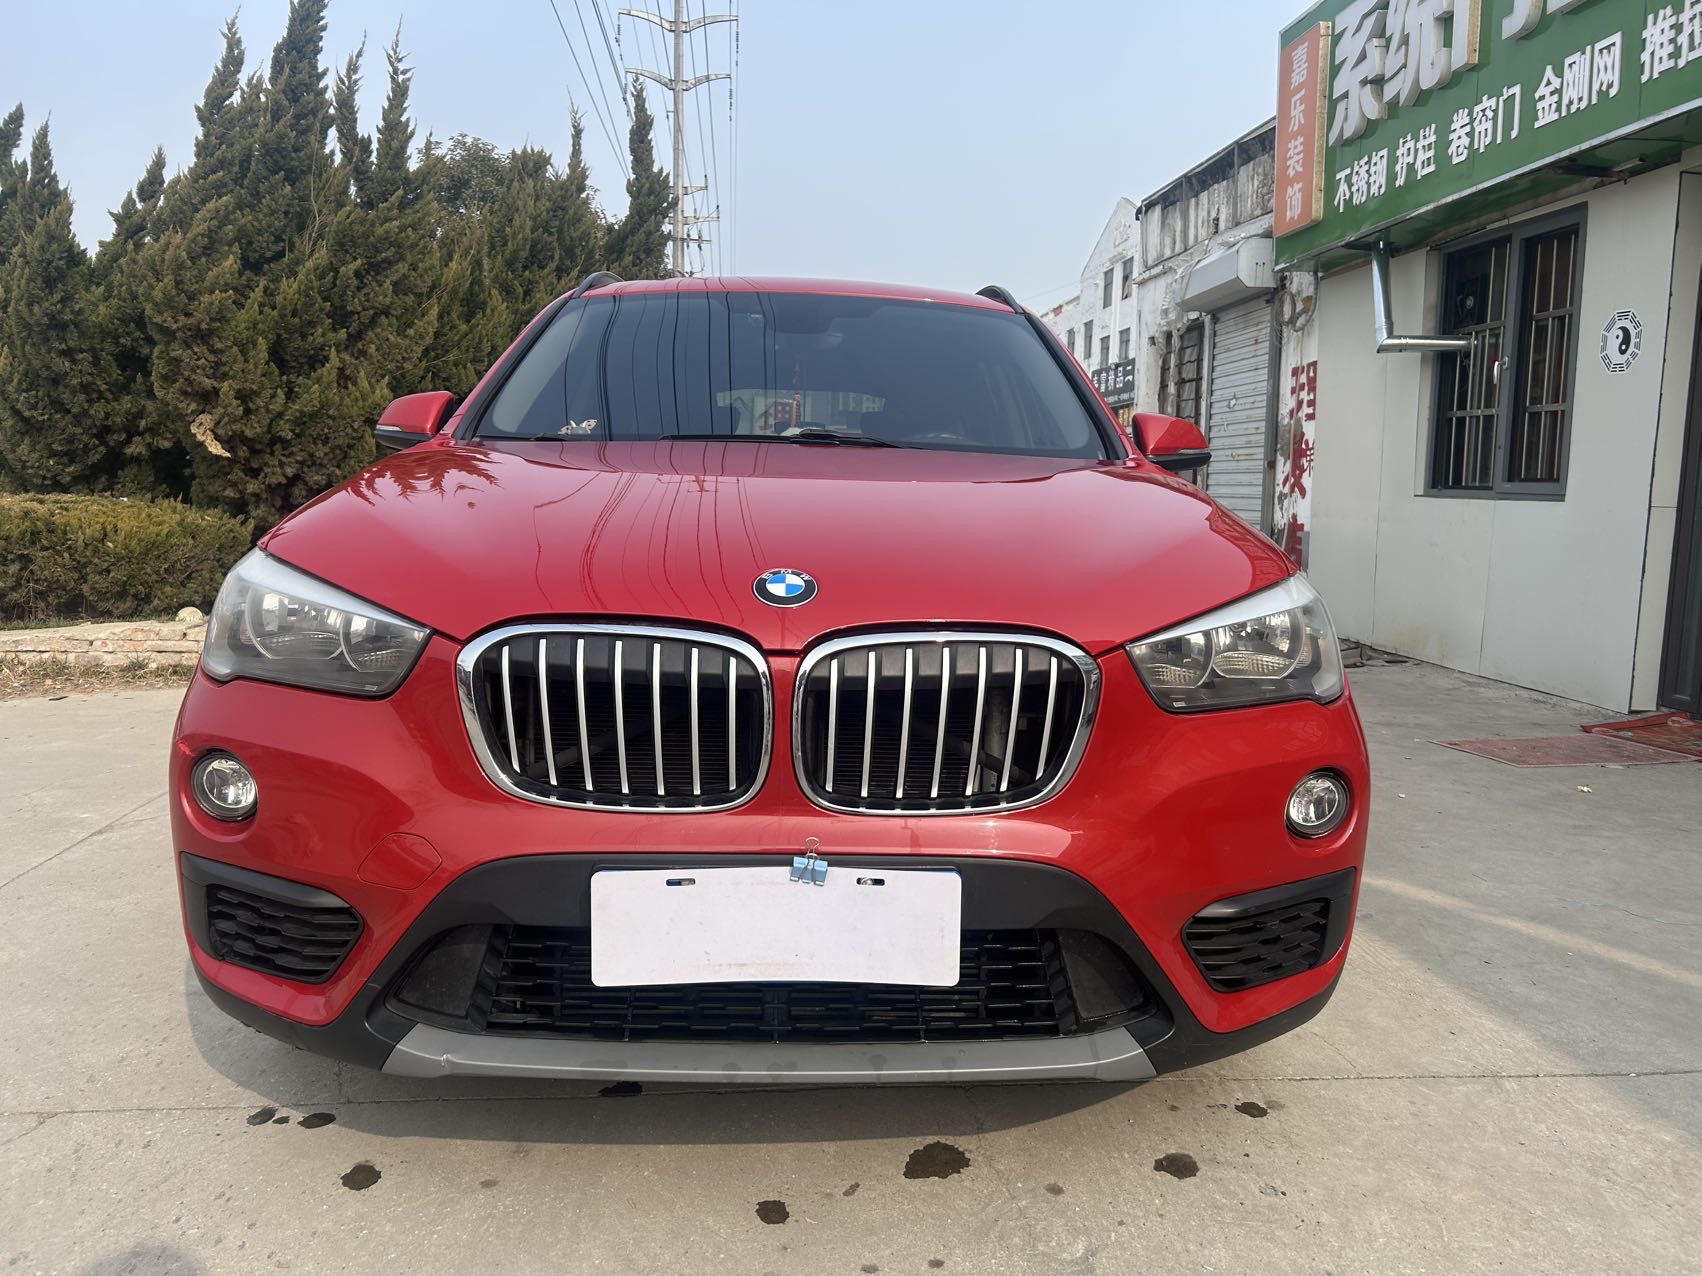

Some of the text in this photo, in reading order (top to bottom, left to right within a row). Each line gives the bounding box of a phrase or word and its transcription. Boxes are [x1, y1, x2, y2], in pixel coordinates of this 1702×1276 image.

[1285, 41, 1309, 222] 嘉乐装饰
[1334, 147, 1389, 213] 不锈钢
[1395, 123, 1438, 188] 护栏
[1448, 83, 1522, 165] 卷帘门
[1534, 31, 1624, 129] 金刚网
